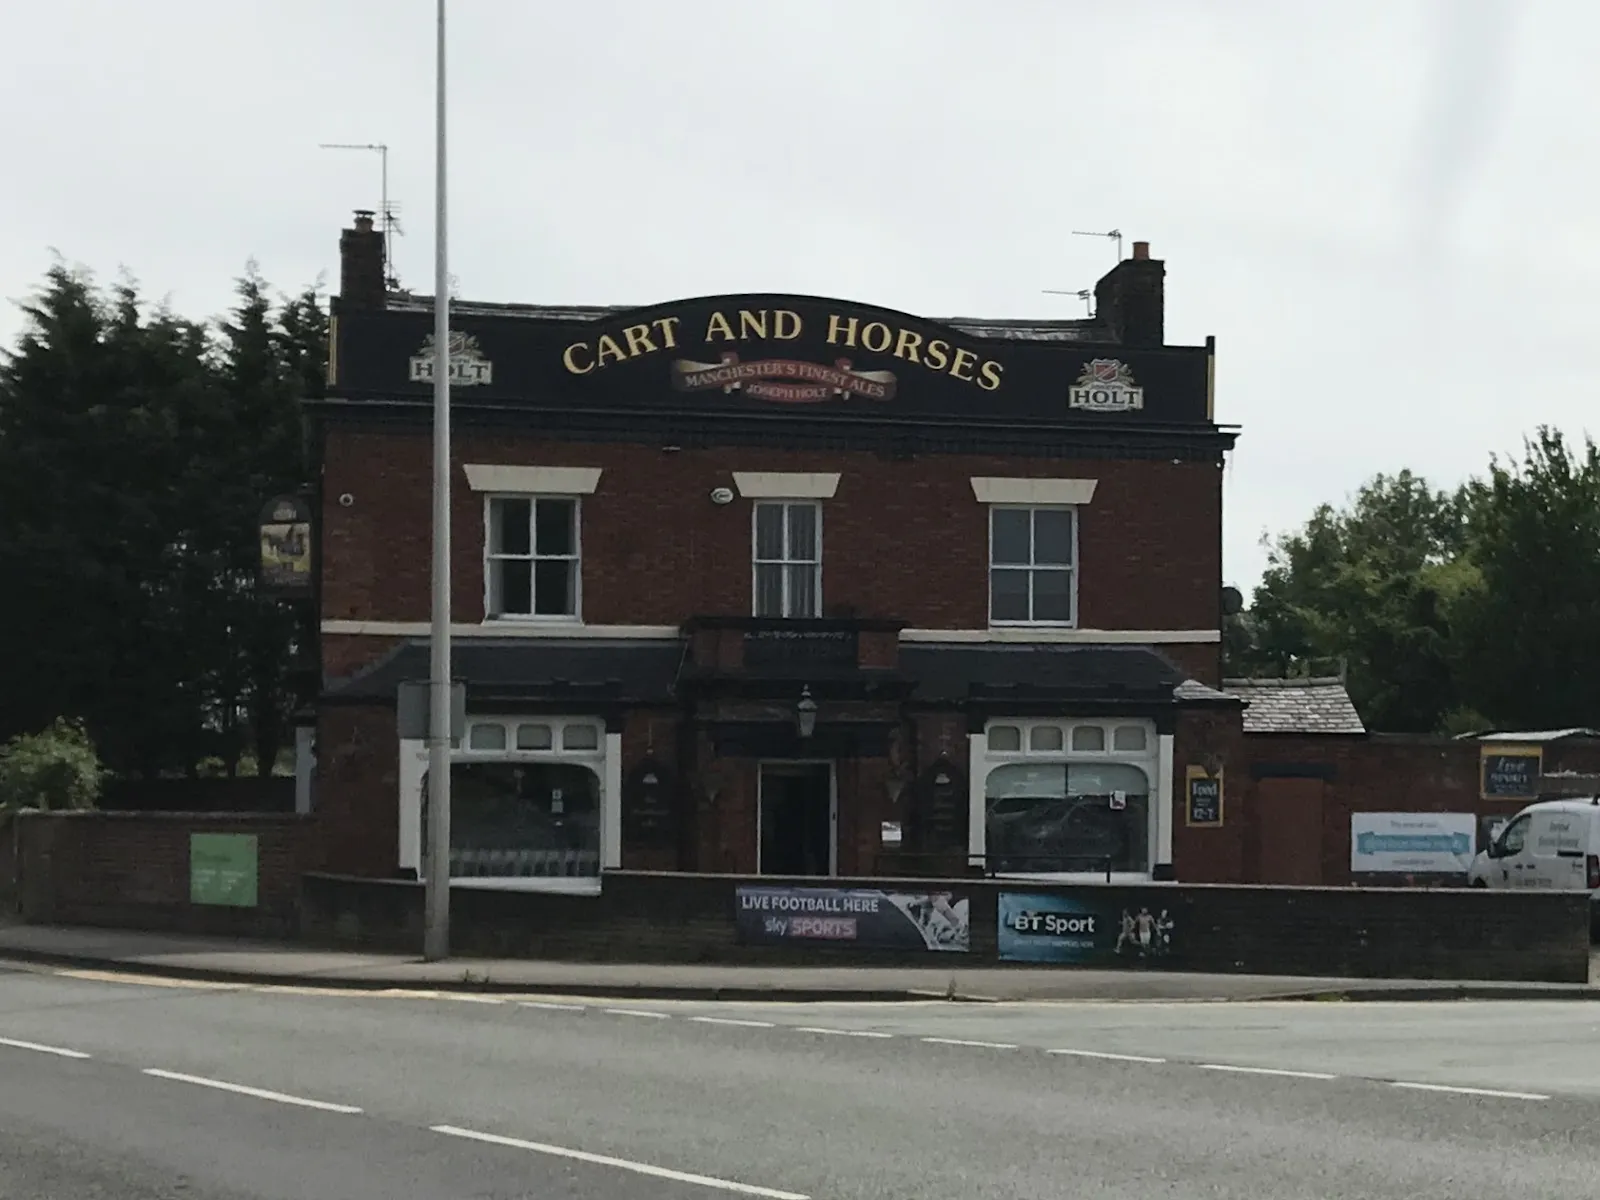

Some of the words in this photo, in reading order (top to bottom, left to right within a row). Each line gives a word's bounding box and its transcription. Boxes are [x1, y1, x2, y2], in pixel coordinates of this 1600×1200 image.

[562, 315, 682, 376] CART
[704, 309, 803, 343] AND
[826, 314, 1005, 392] HORSES
[684, 362, 796, 388] MANCHESTER'S
[798, 364, 849, 386] FINEST
[849, 379, 885, 398] ALES
[746, 384, 794, 400] JOSEPH
[795, 386, 828, 400] HOLT
[1073, 389, 1140, 404] HOLT
[741, 896, 772, 910] LIVE
[772, 896, 841, 912] FOOTBALL
[843, 898, 879, 913] HERE
[764, 916, 788, 936] sky
[791, 918, 854, 937] SPORTS
[1014, 915, 1043, 931] BT
[1045, 914, 1095, 934] Sport
